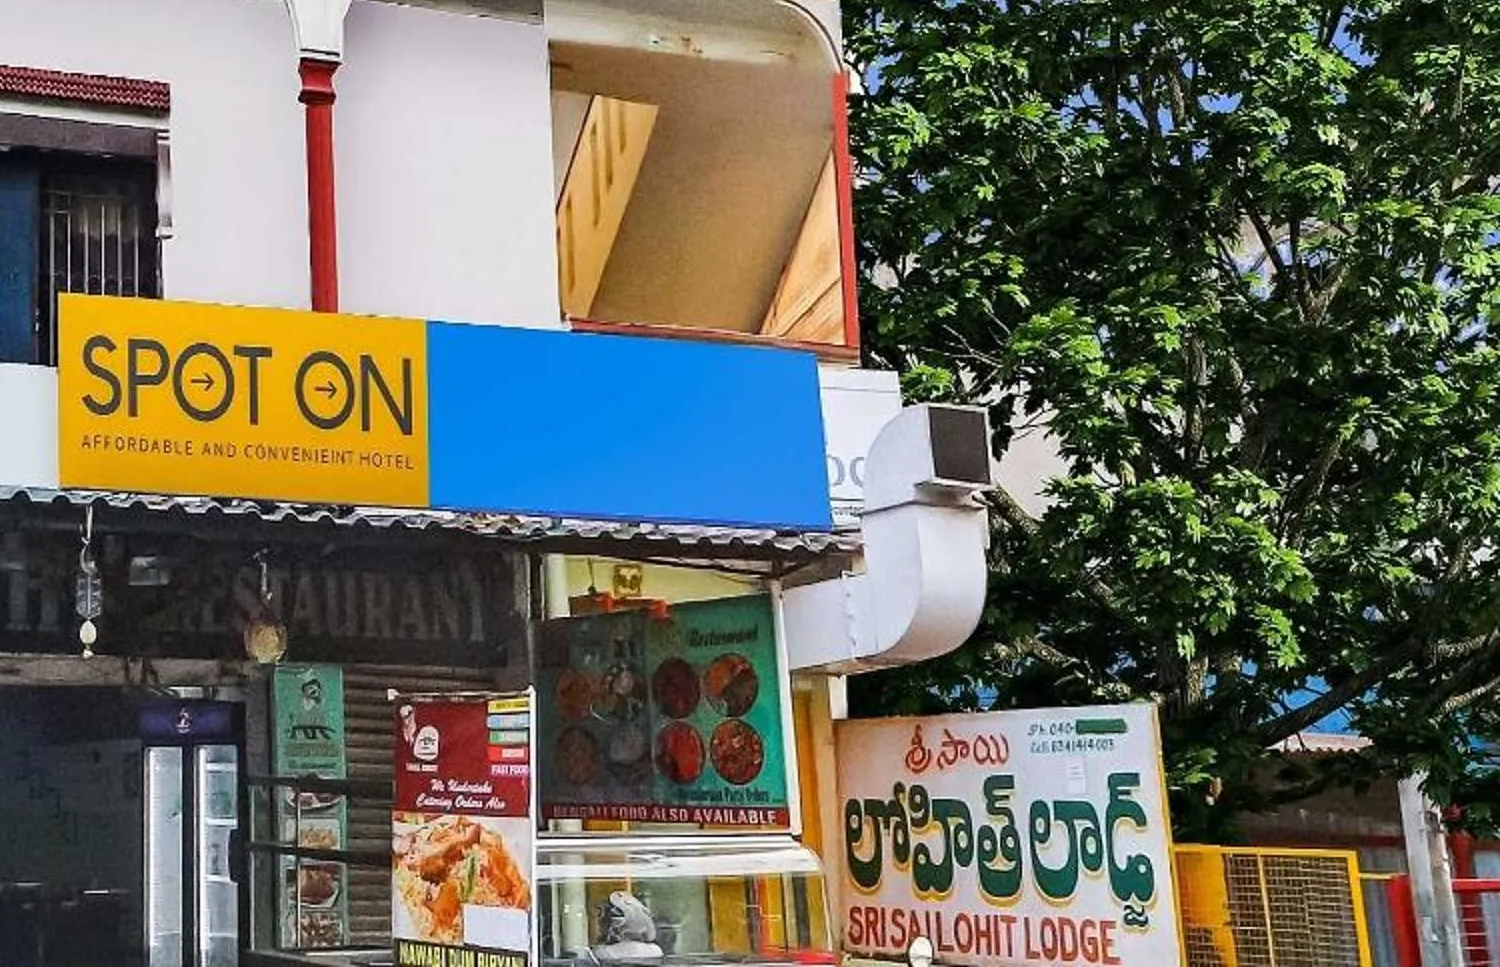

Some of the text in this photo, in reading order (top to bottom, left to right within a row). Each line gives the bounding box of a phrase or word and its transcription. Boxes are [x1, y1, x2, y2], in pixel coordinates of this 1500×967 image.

[81, 334, 414, 436] SPOT ON
[80, 433, 195, 457] AFFORDABLE
[201, 443, 238, 459] AND
[358, 452, 415, 471] HOTEL
[937, 728, 1009, 770] సాయి
[454, 794, 483, 809] Orders
[484, 795, 506, 810] Also
[611, 805, 648, 821] FOOD
[650, 805, 689, 822] ALSO
[692, 806, 777, 825] AVAILABLE
[848, 906, 1122, 966] SRI SAI LOHIT LODGE
